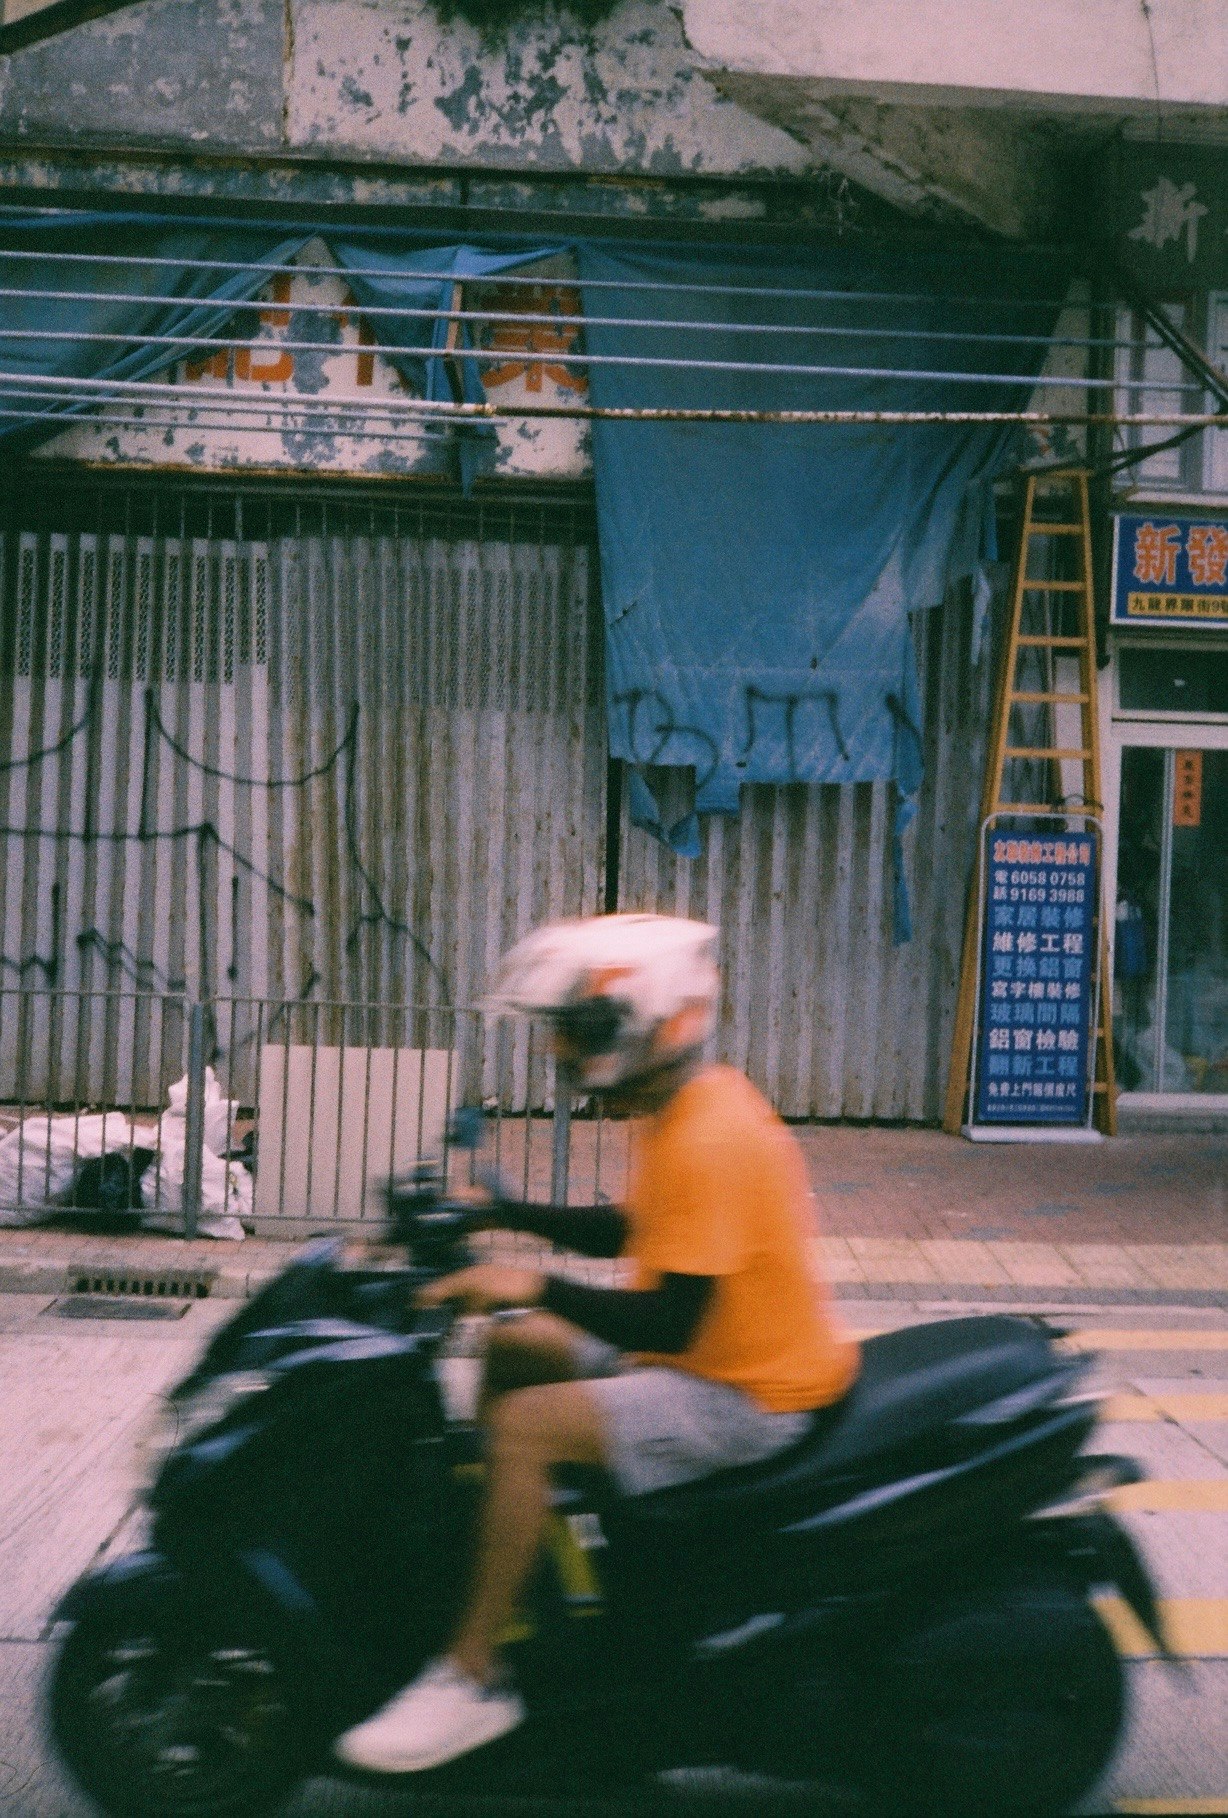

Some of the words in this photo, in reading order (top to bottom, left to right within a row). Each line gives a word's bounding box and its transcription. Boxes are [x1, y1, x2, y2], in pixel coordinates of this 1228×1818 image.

[1133, 522, 1228, 586] 新發
[1010, 870, 1047, 885] 6058
[1049, 871, 1085, 886] 0758
[992, 931, 1084, 954] 維修工程
[991, 955, 1083, 979] 更換鋁窗
[991, 980, 1081, 999] 寫字樓裝修
[989, 1002, 1081, 1025] 玻璃間隔
[988, 1028, 1079, 1051] 鋁窗檢驗
[987, 1054, 1079, 1077] 翻新工程
